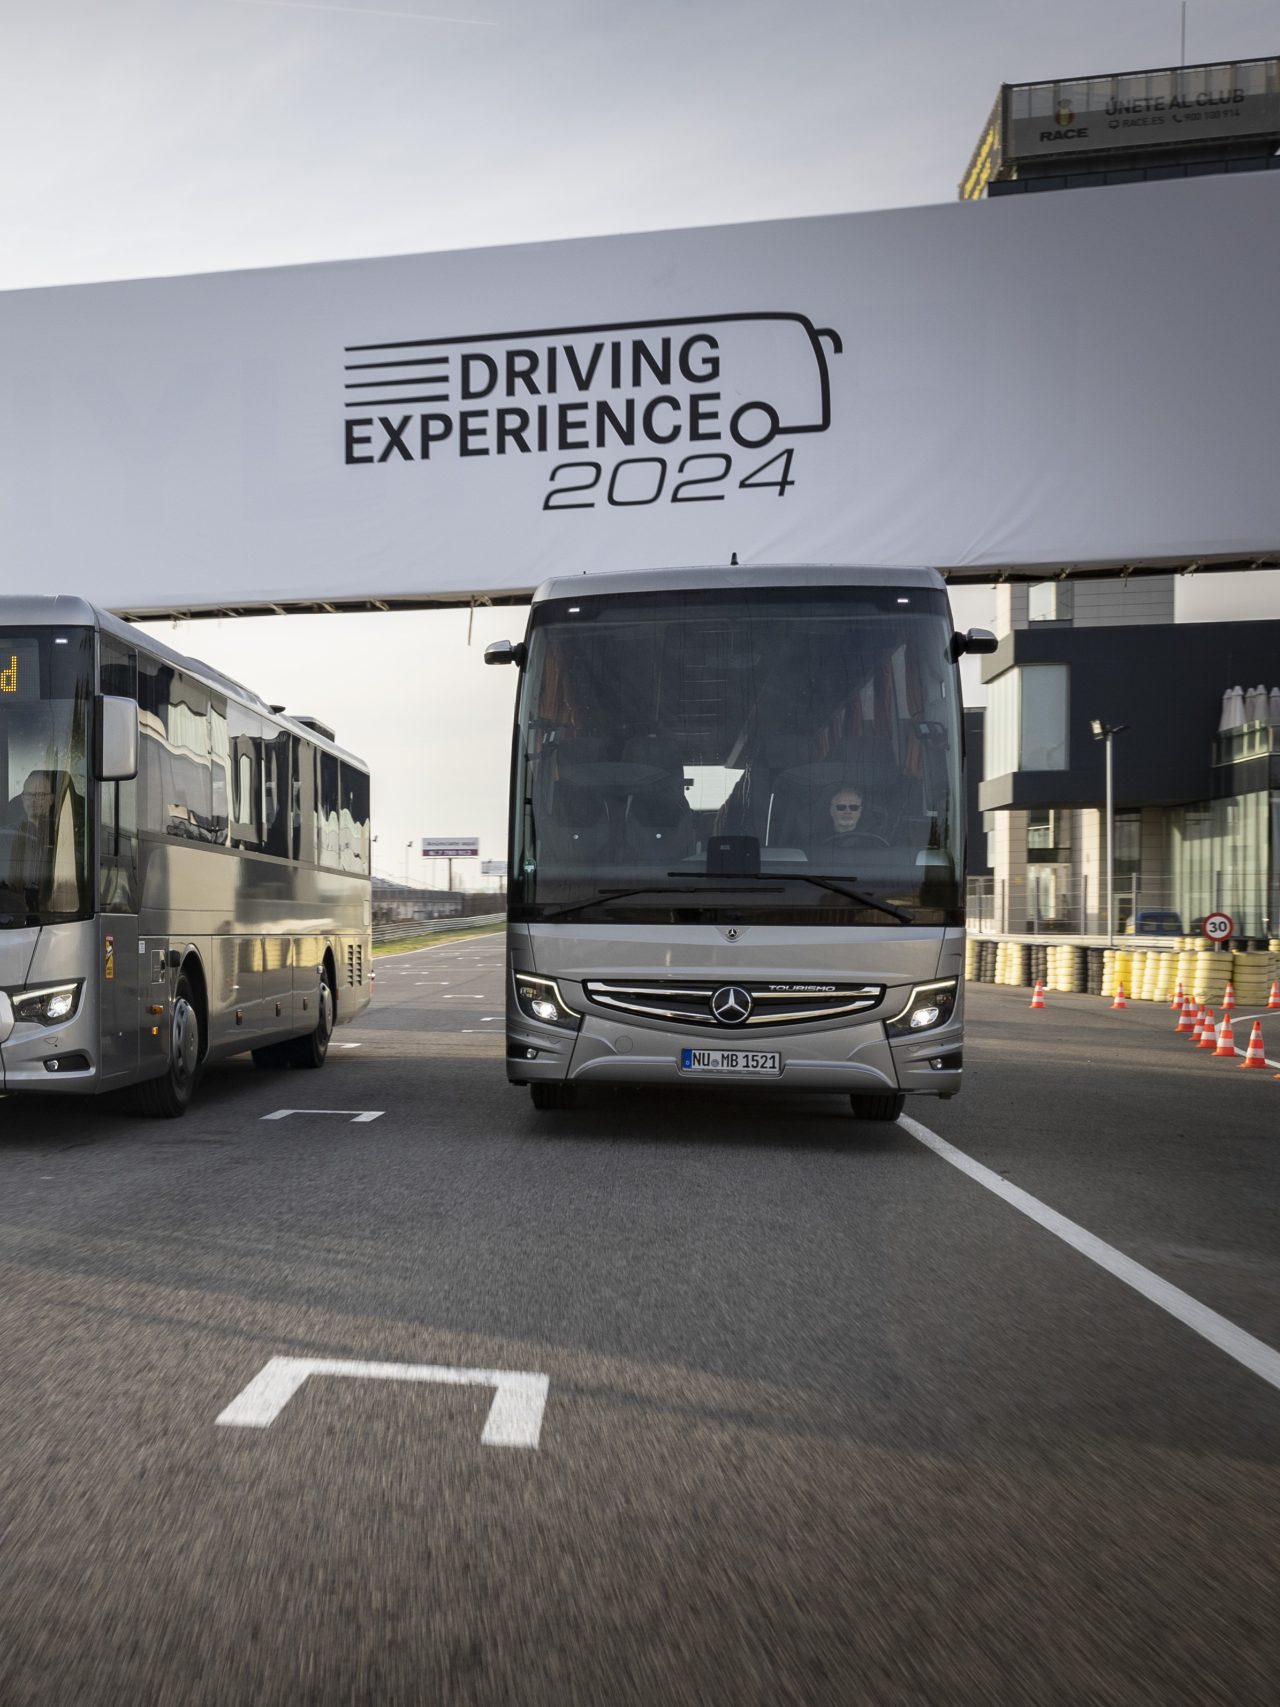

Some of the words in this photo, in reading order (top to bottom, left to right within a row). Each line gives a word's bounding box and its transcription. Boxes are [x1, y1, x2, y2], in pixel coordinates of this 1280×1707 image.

[1105, 96, 1166, 116] ÚNETE
[1168, 94, 1193, 110] AL
[1195, 88, 1246, 107] CLUB
[1039, 127, 1089, 142] RACE
[460, 333, 721, 401] DRIVING
[344, 391, 722, 466] EXPERIENCE
[542, 448, 796, 511] 2024
[1208, 920, 1228, 934] 30
[768, 984, 836, 992] TOURISMO
[692, 1052, 711, 1067] NU
[721, 1053, 739, 1068] MB
[742, 1054, 777, 1070] 1521
